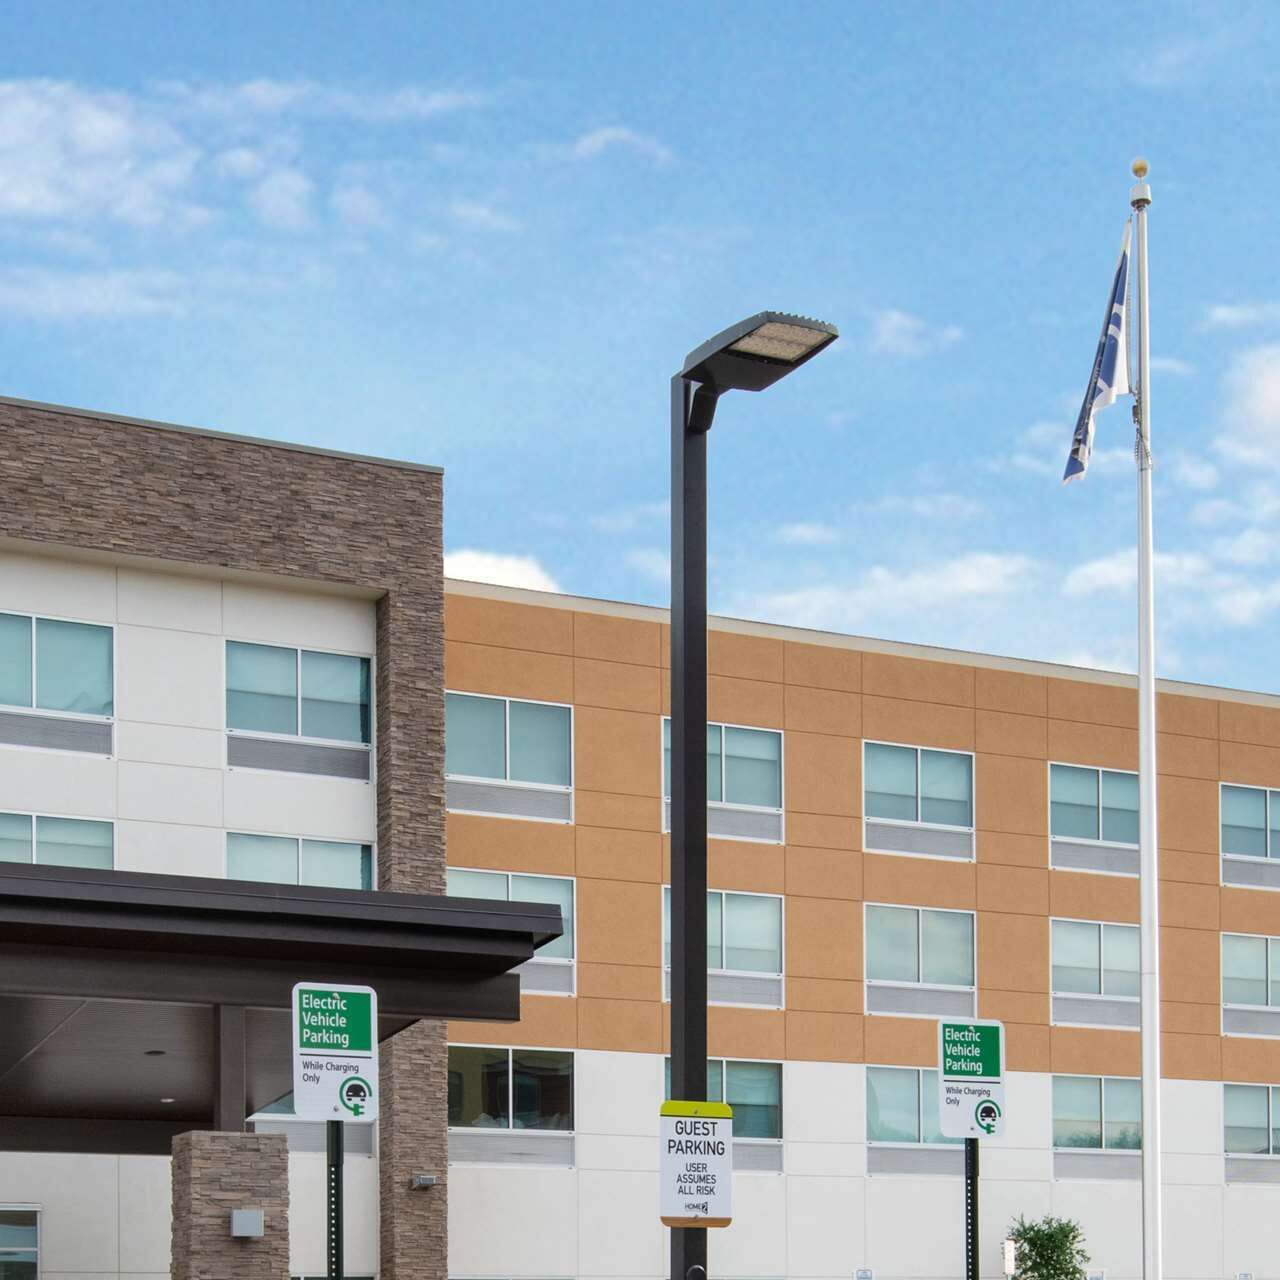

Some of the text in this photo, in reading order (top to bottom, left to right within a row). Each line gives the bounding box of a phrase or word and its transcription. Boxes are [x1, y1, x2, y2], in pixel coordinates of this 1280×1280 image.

[302, 994, 347, 1010] Electric
[302, 1011, 347, 1027] Vehicle
[303, 1029, 349, 1048] Parking
[945, 1028, 981, 1042] Electric
[945, 1043, 980, 1057] Vehicle
[302, 1061, 359, 1074] While Charging
[946, 1058, 983, 1075] Parking
[302, 1073, 320, 1085] Only
[945, 1086, 991, 1097] While Charging
[945, 1097, 960, 1106] Only
[675, 1120, 718, 1136] GUEST
[667, 1139, 725, 1156] PARKING
[685, 1163, 707, 1173] USER
[676, 1174, 717, 1184] ASSUMES
[677, 1186, 716, 1196] ALL RISK
